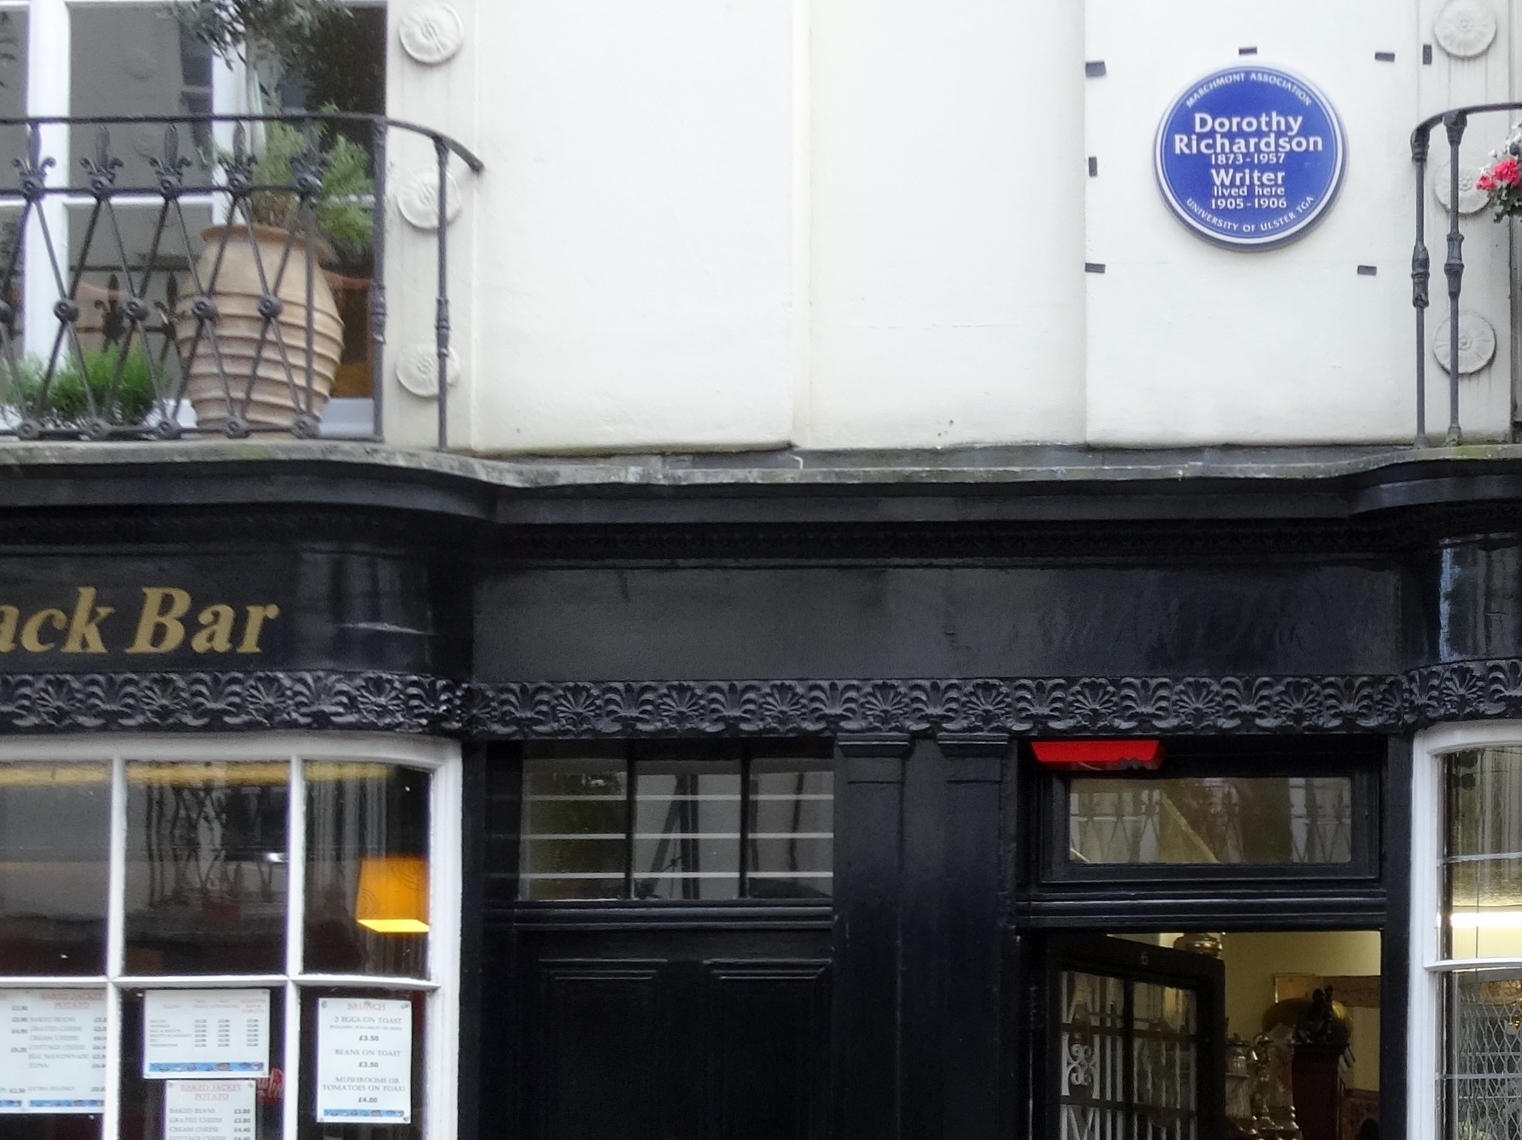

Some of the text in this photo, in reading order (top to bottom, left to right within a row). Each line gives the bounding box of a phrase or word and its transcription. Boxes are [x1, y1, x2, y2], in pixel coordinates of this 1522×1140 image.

[1186, 72, 1312, 108] MARCHMONT ASSOCIATION
[1194, 111, 1302, 135] Dorothy
[1174, 133, 1322, 154] Richardson
[1211, 168, 1285, 186] Writer
[1214, 186, 1285, 196] lived here
[1186, 196, 1315, 232] UNIVERSITY OF ULSTER TGA
[125, 587, 279, 653] Bar
[347, 1002, 386, 1011] BRUNCH
